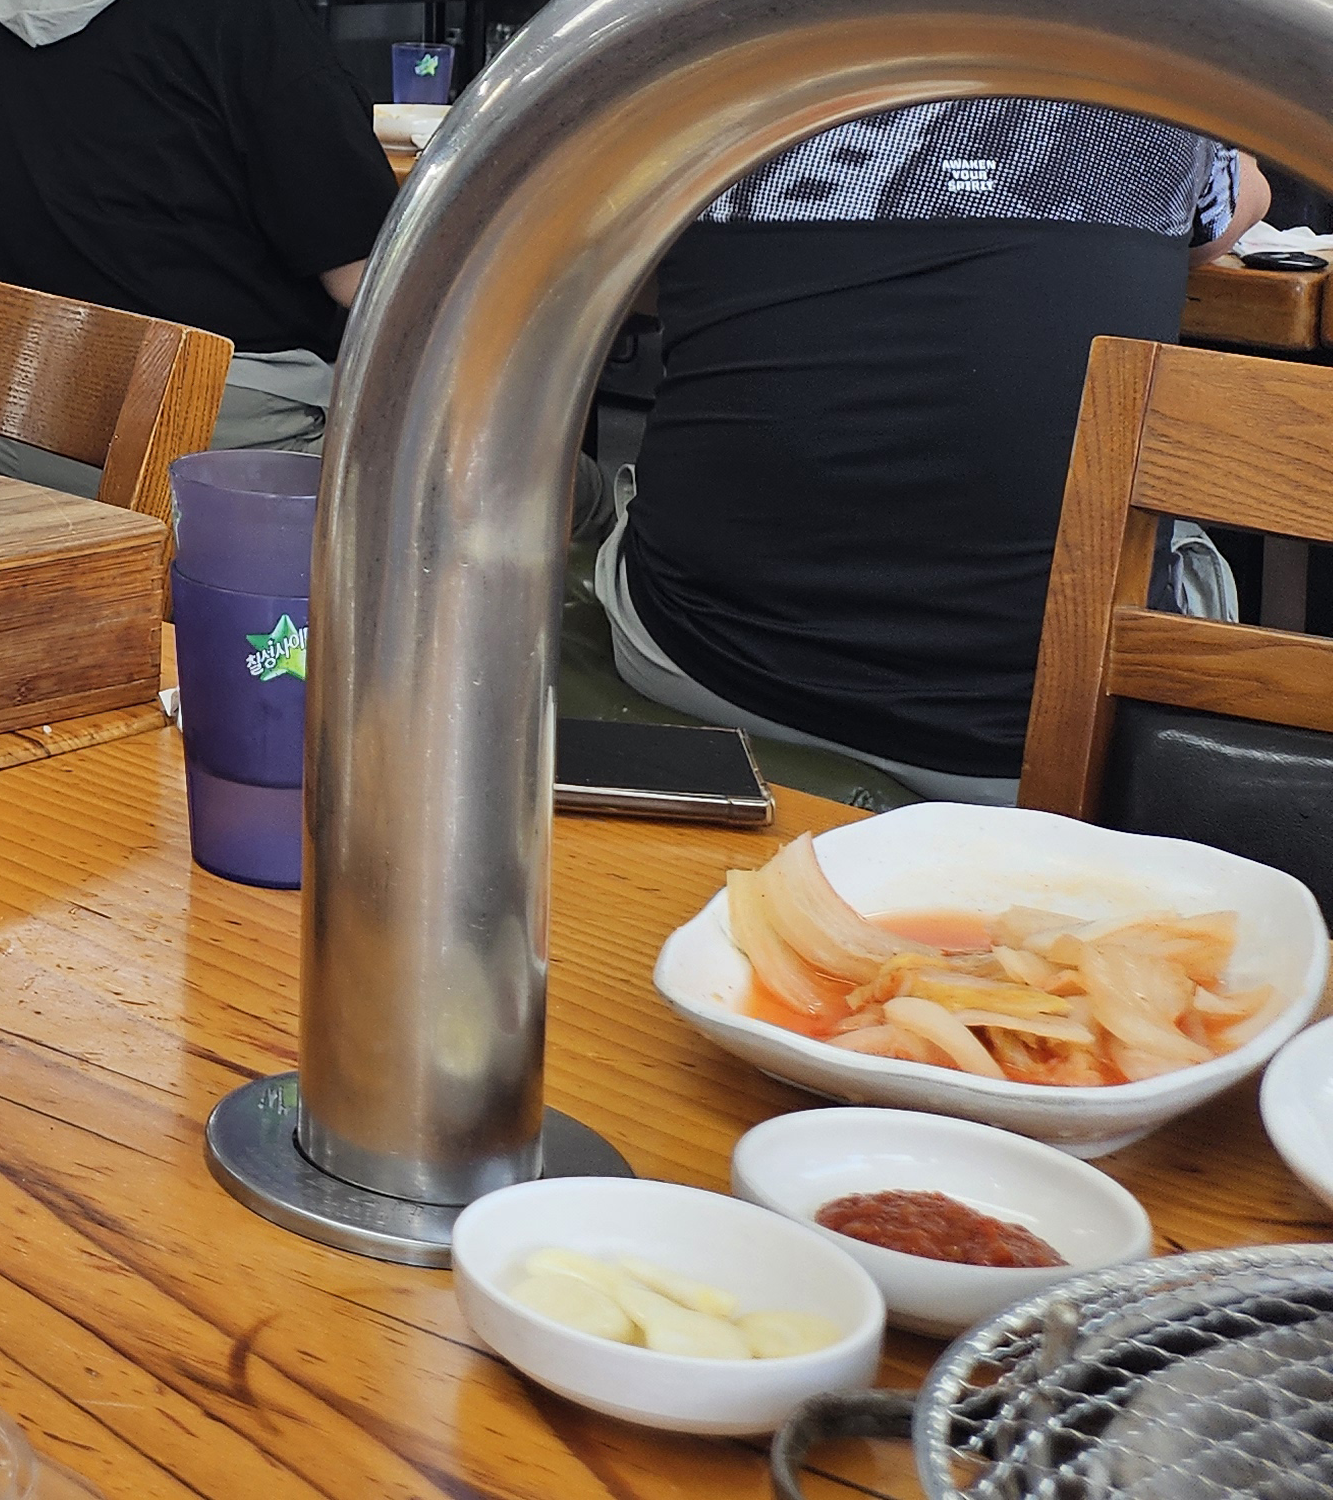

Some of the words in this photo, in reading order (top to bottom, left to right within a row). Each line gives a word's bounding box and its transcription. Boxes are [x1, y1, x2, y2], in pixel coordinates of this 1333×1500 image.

[942, 158, 997, 171] AWAKEN
[952, 169, 988, 181] YOUR
[245, 626, 309, 676] 칠성사이
